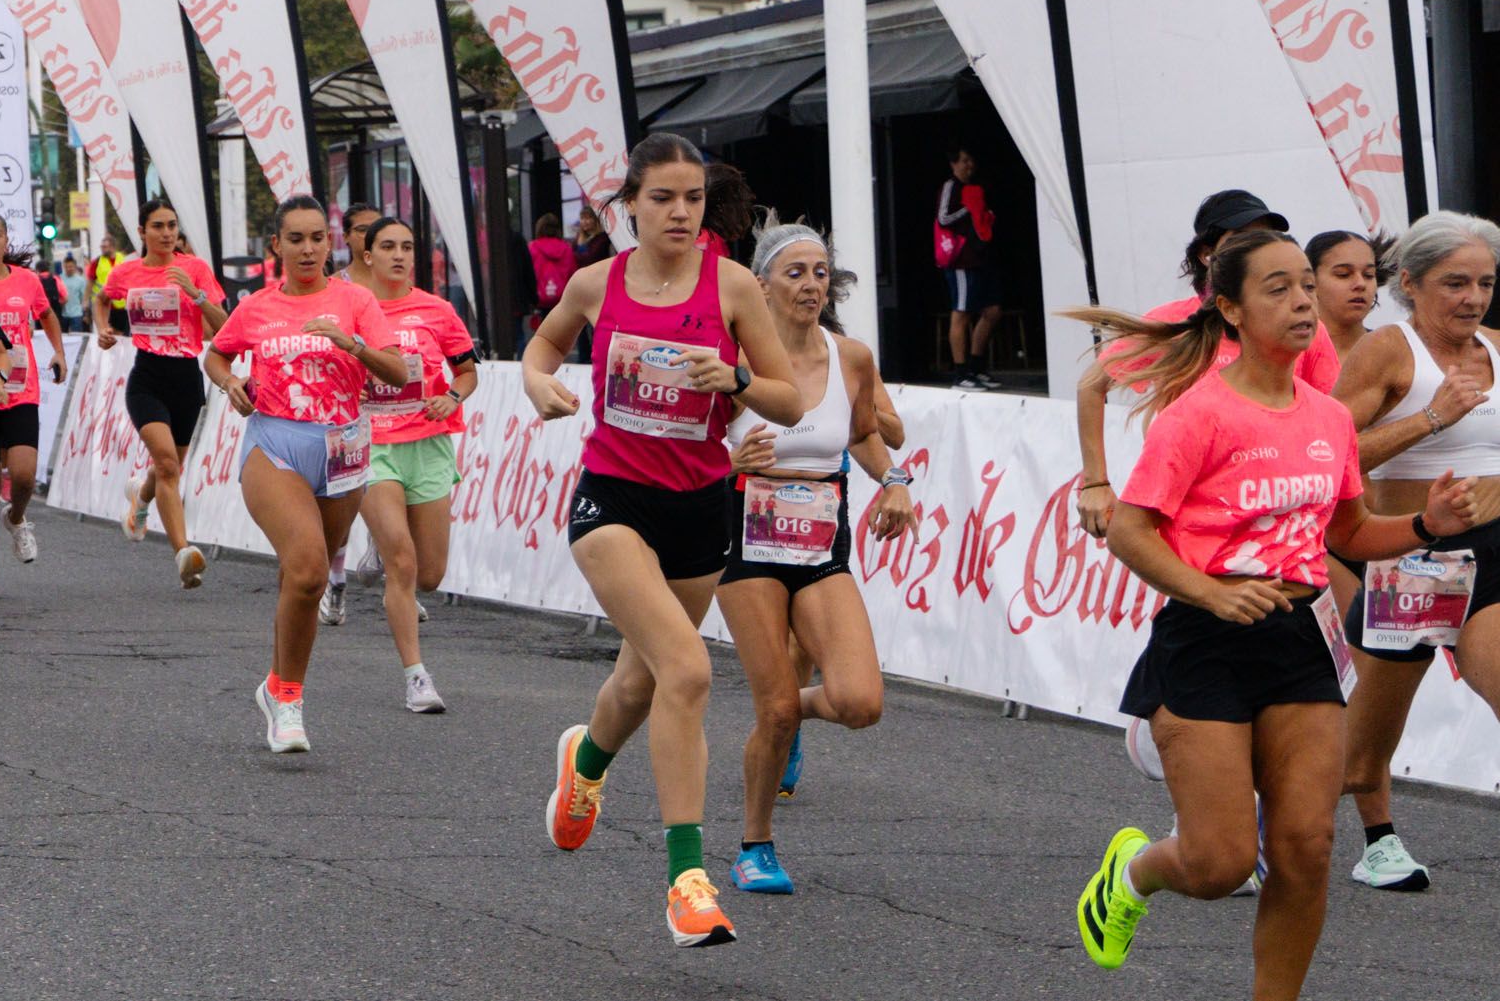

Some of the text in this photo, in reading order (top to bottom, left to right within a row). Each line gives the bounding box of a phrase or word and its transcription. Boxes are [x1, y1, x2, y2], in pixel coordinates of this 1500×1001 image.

[638, 383, 680, 404] 016
[1469, 407, 1496, 417] OYSHO
[613, 415, 644, 428] OYSHO
[783, 425, 815, 436] OYSHO
[1231, 447, 1278, 464] OYSHO
[1240, 474, 1334, 510] CARRERA
[775, 517, 812, 534] 016
[953, 460, 1016, 603] de
[754, 549, 785, 558] OYSHO
[1398, 592, 1436, 611] 016
[1376, 633, 1409, 643] OYSHO
